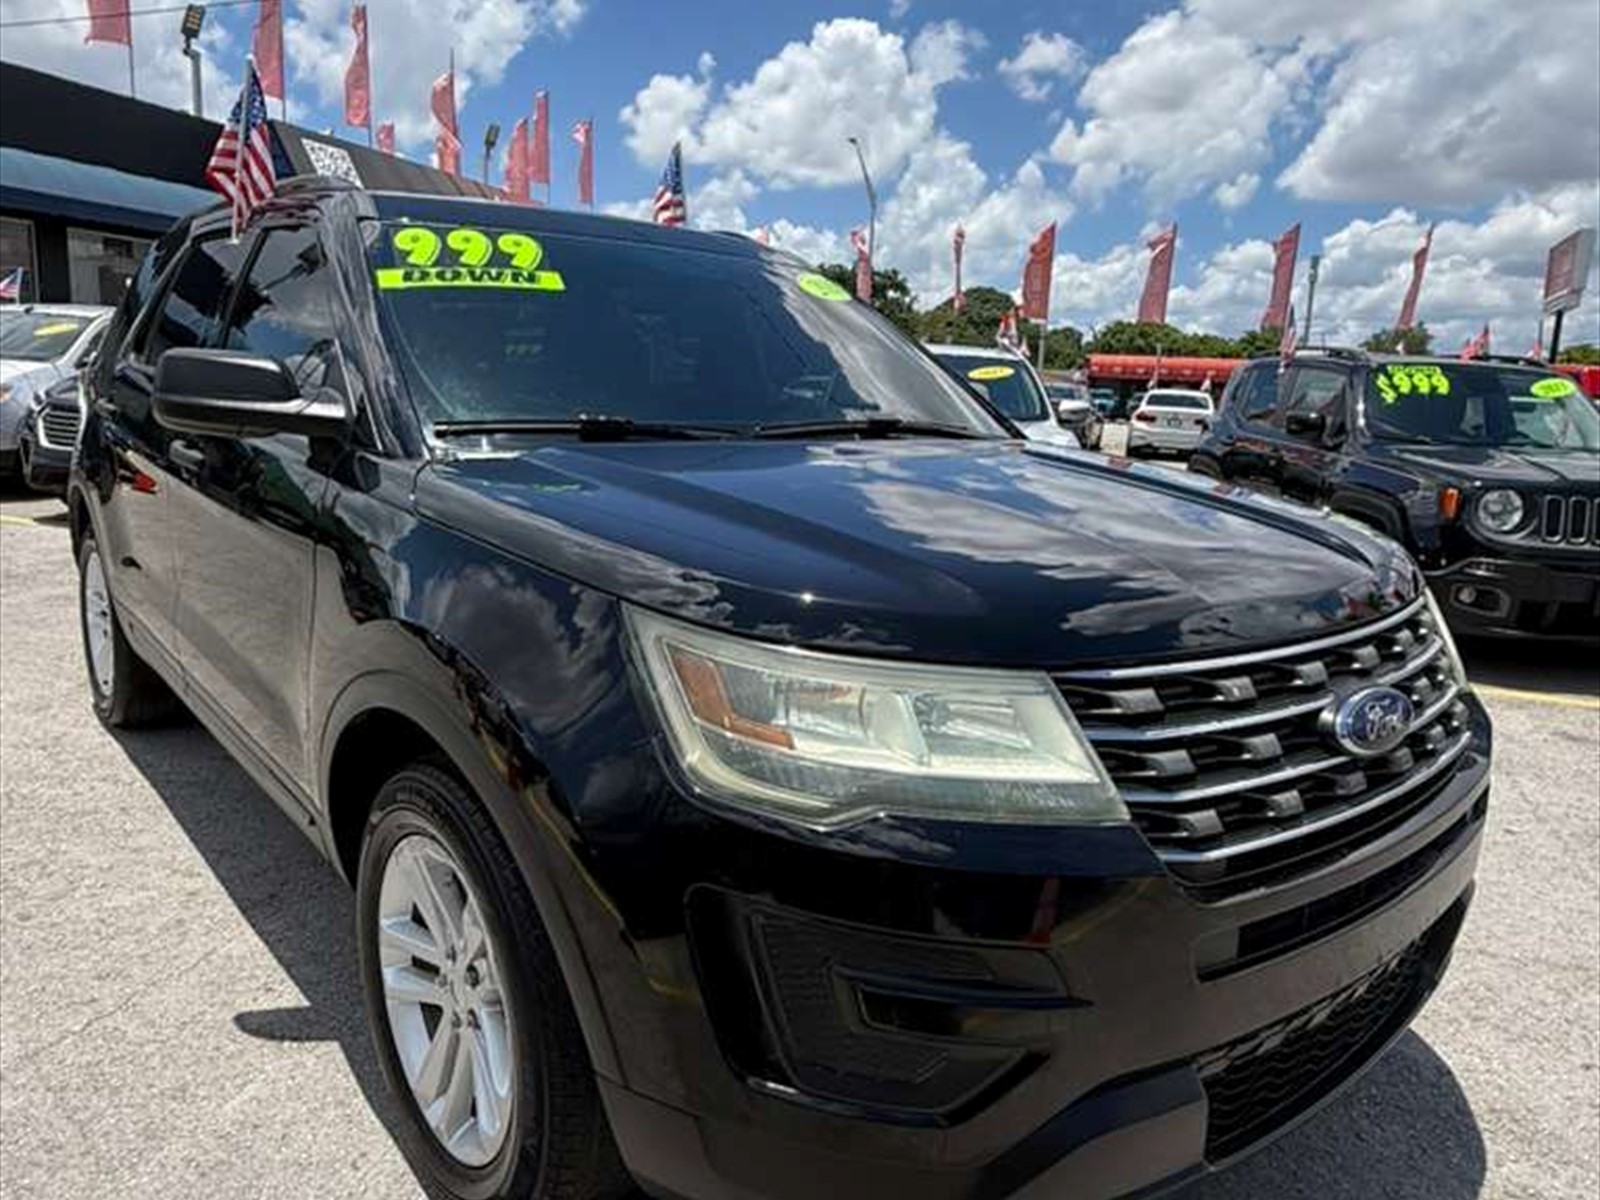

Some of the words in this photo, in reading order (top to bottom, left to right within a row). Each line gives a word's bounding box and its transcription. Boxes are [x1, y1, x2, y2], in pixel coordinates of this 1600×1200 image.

[394, 227, 542, 271] 999
[402, 269, 537, 283] DOWN
[1376, 372, 1449, 403] $999
[1365, 698, 1403, 740] Ford
